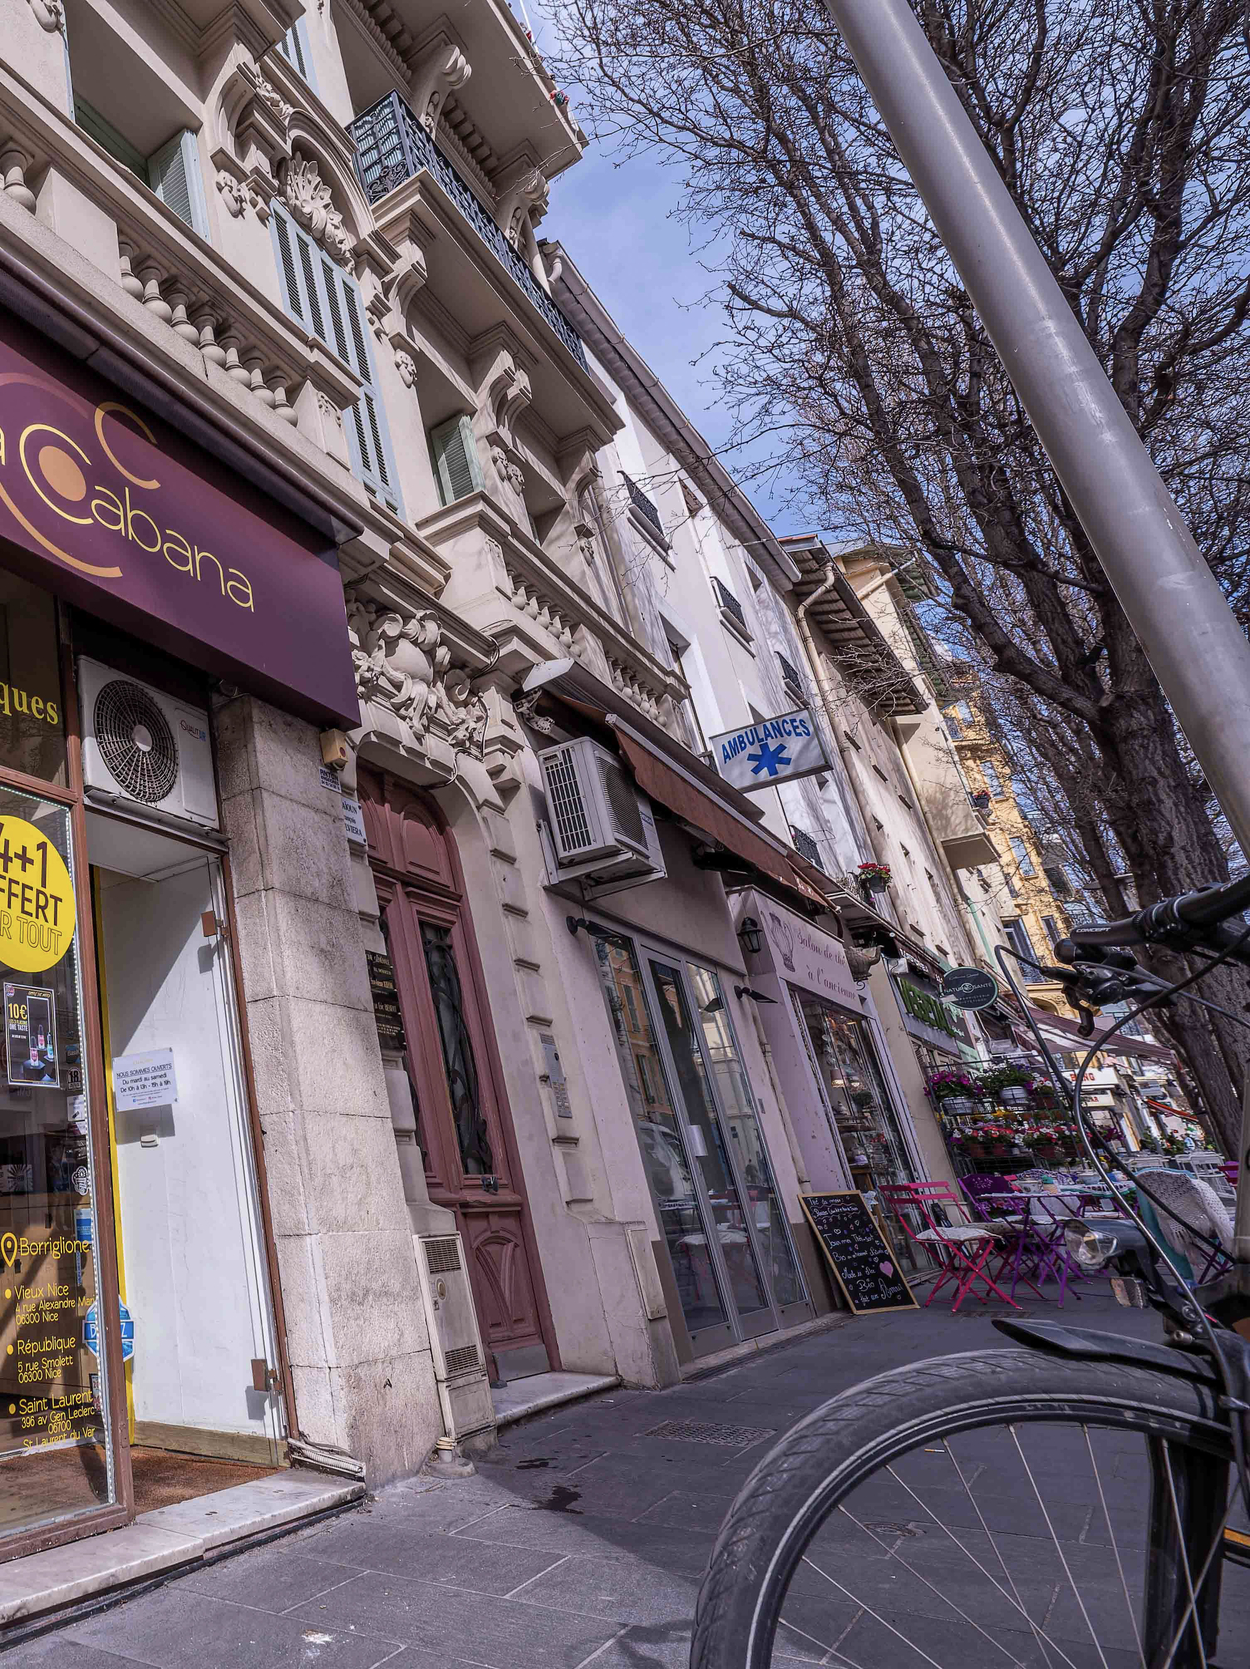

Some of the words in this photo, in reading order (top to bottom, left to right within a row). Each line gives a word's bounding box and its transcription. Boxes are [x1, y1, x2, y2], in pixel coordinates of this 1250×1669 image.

[721, 719, 810, 764] AMBULANCES
[17, 916, 62, 955] TOUT
[824, 944, 832, 961] de
[8, 1003, 27, 1019] 10€
[117, 1070, 129, 1078] NOUS
[130, 1067, 150, 1076] SOMMES
[151, 1063, 172, 1072] OUVERTS
[151, 1072, 167, 1080] samedi
[20, 1237, 90, 1259] Borriglione
[15, 1285, 44, 1301] Vieux
[47, 1283, 69, 1296] Nice
[22, 1302, 37, 1312] rue
[39, 1298, 75, 1311] Alexandre
[42, 1312, 59, 1323] Nice
[17, 1335, 76, 1357] République
[18, 1362, 23, 1372] 5
[25, 1361, 39, 1372] rue
[42, 1355, 73, 1369] Smolett
[18, 1371, 43, 1384] 06300
[45, 1369, 62, 1380] Nice
[19, 1398, 48, 1415] Saint
[52, 1390, 94, 1408] Laurent
[22, 1417, 35, 1428] 396
[37, 1417, 46, 1426] av
[50, 1411, 66, 1423] Gen
[68, 1406, 95, 1421] Leclerc
[48, 1420, 71, 1433] 06700
[23, 1438, 32, 1449] St
[71, 1430, 81, 1441] du
[83, 1427, 95, 1438] Var
